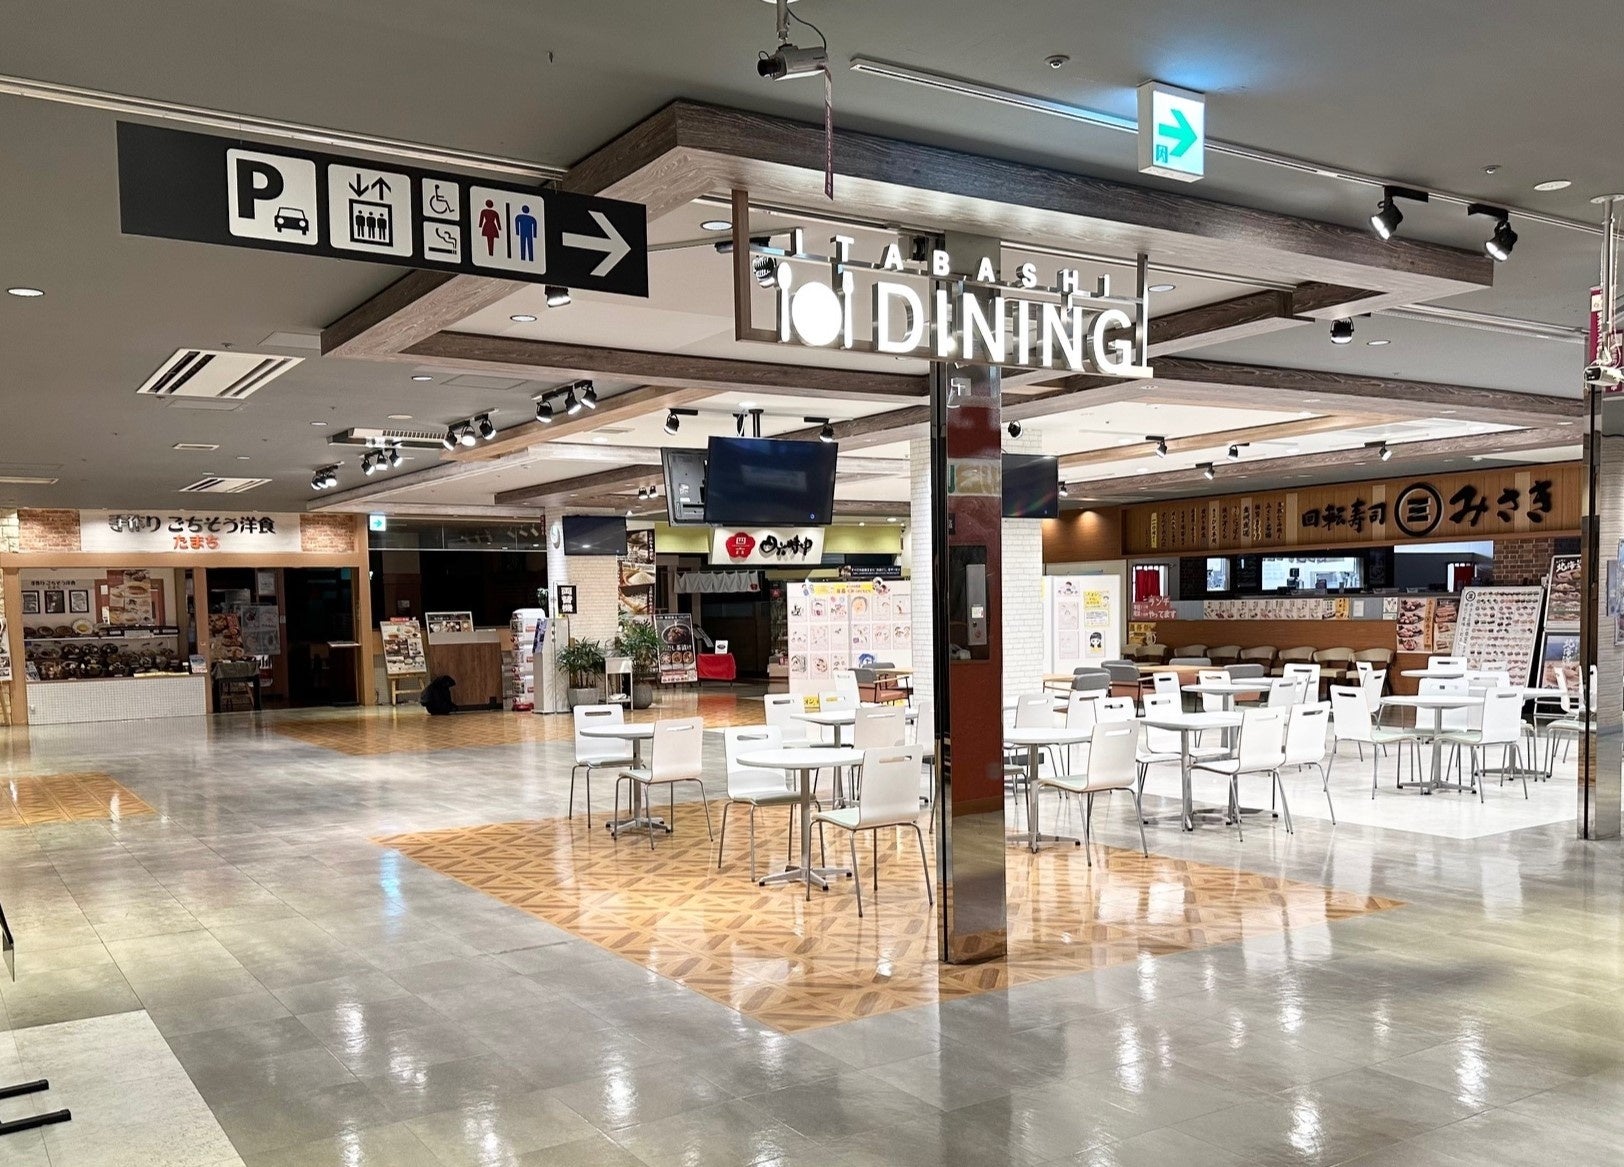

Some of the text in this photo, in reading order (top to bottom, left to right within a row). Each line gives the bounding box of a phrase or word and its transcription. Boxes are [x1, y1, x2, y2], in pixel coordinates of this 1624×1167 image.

[236, 158, 284, 219] P
[790, 228, 1110, 298] ITABASHI
[872, 281, 1134, 376] DINING
[108, 514, 276, 534] 手作り ごちそう洋食
[1301, 498, 1387, 533] 回転寿司
[1449, 479, 1553, 527] みさき
[173, 535, 220, 550] たまち
[1148, 609, 1177, 619] やってます
